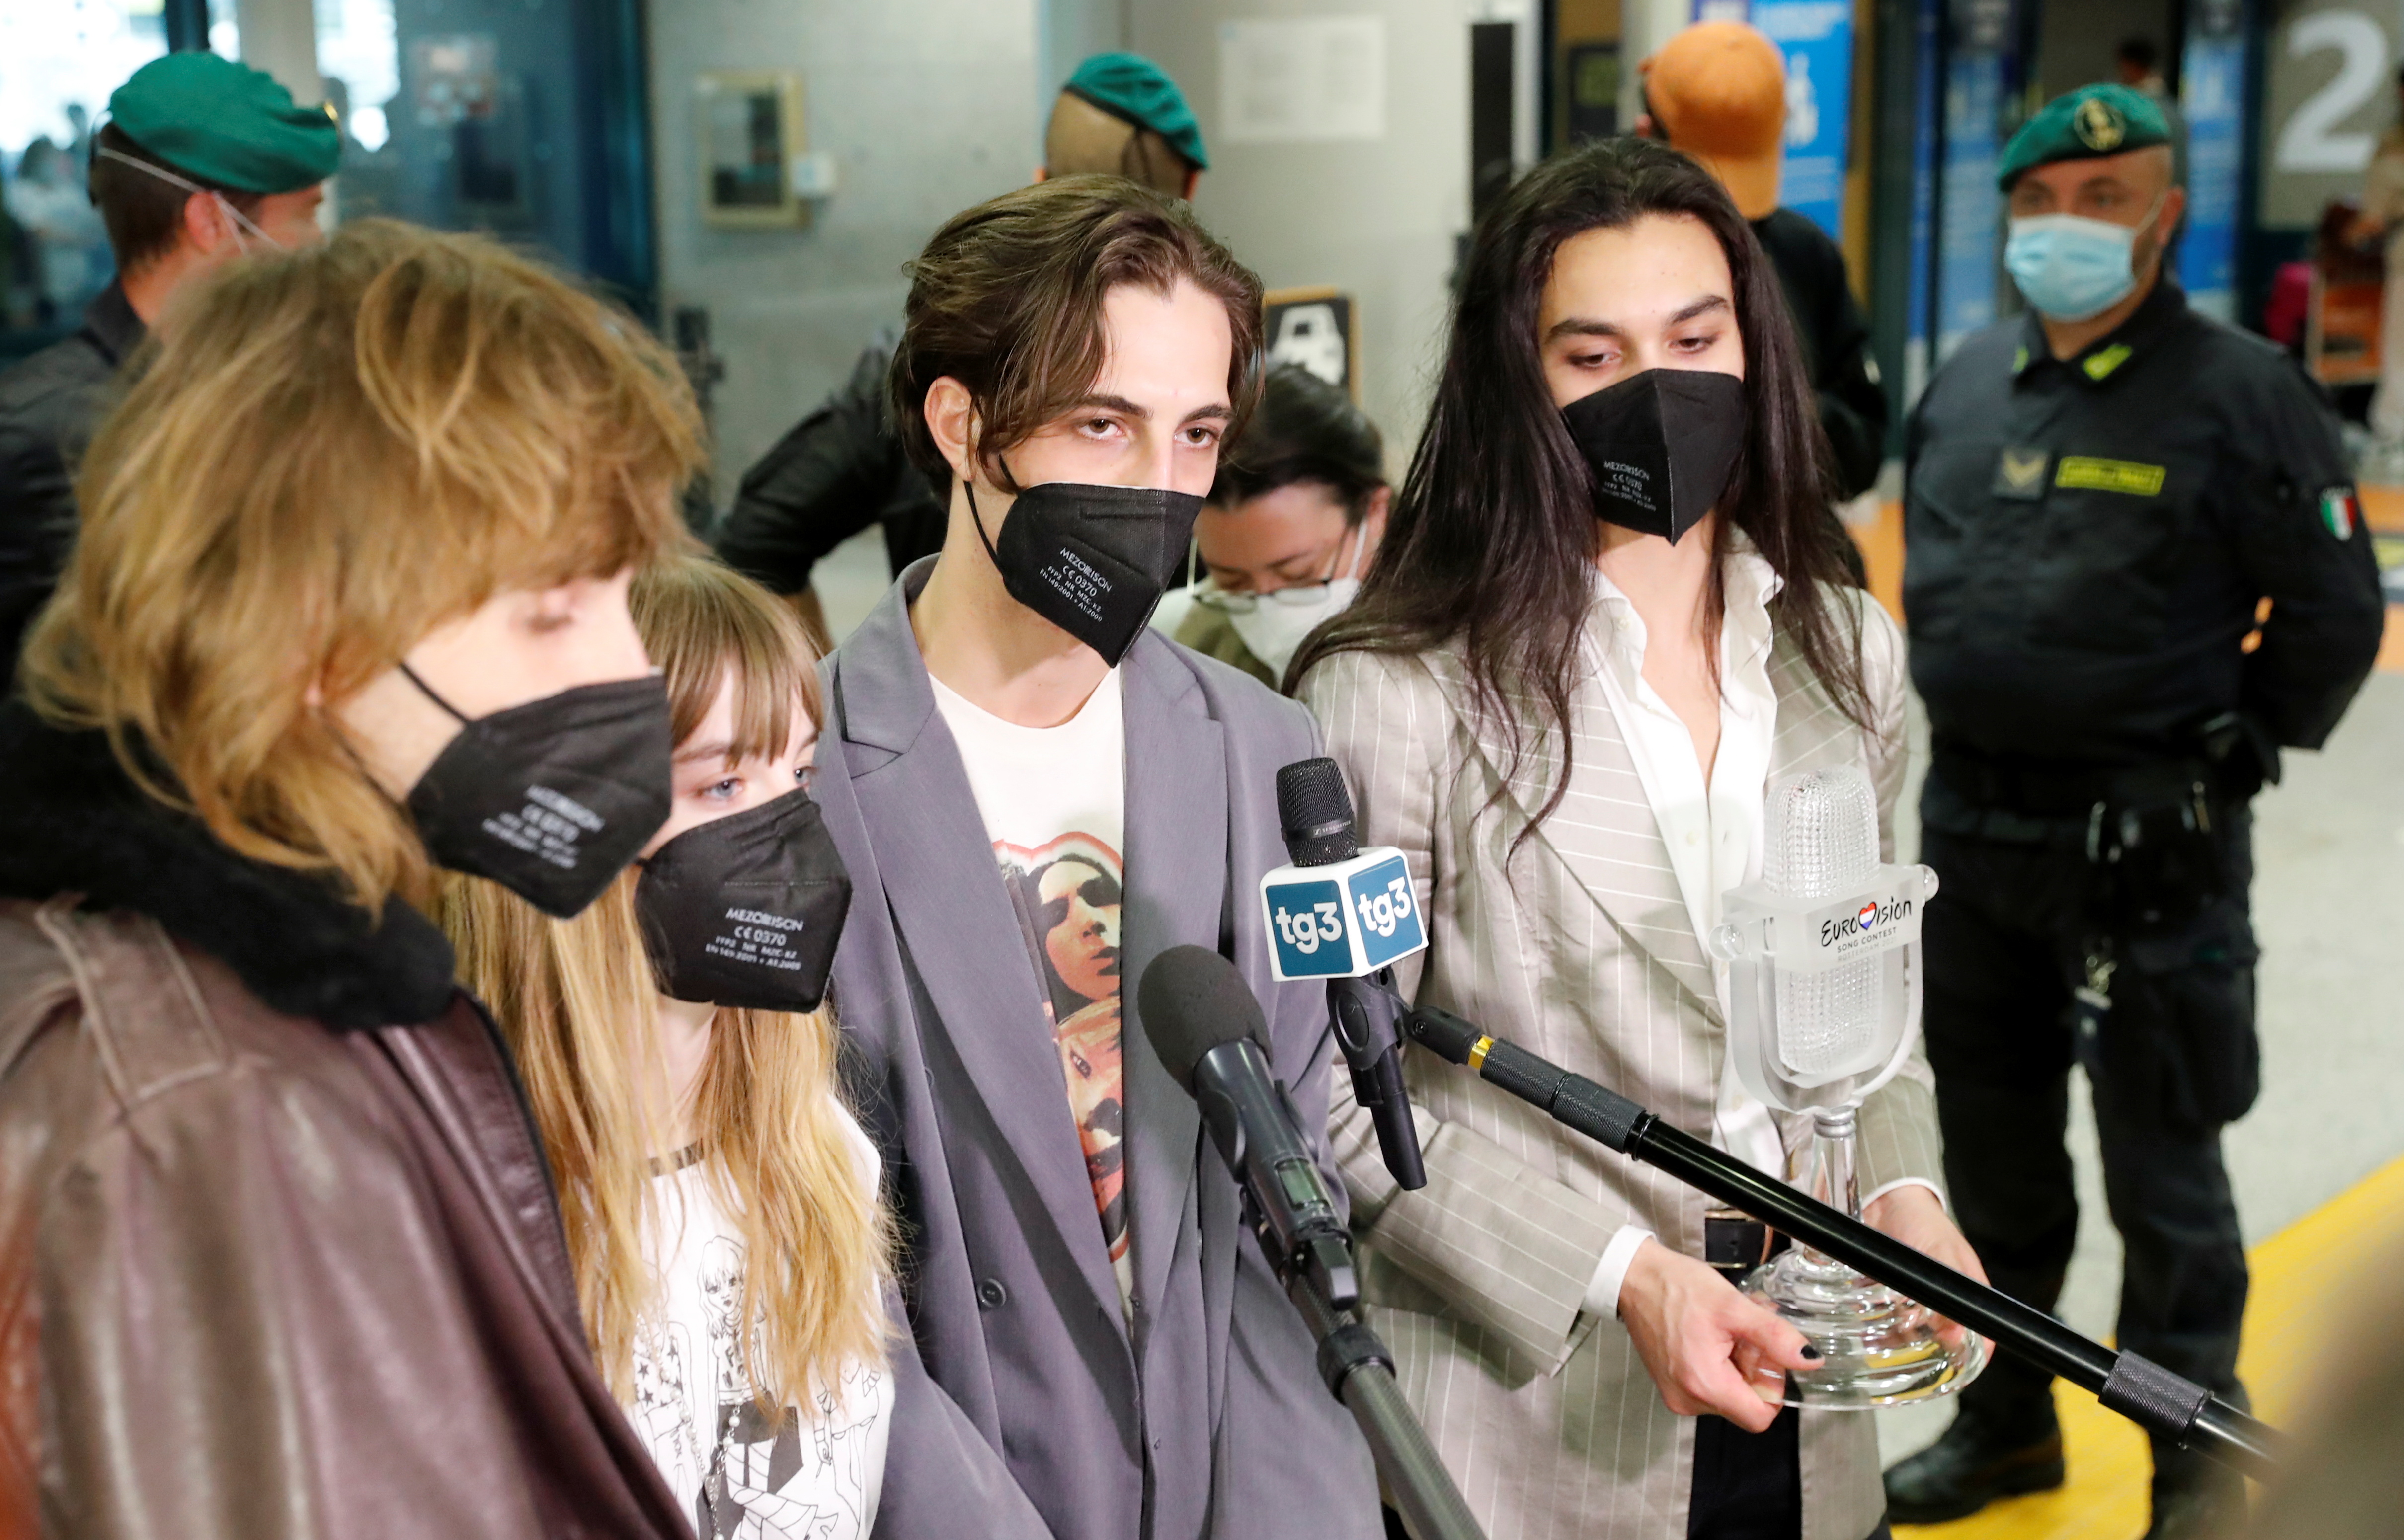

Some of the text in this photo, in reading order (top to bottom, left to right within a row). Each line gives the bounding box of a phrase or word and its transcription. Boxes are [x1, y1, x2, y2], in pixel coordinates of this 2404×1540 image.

[2276, 9, 2384, 171] 2
[1075, 575, 1097, 596] 0370
[1358, 876, 1411, 937] tg3
[753, 928, 787, 946] 0370
[1275, 902, 1343, 954] tg3
[1837, 927, 1897, 953] SONG CONTEST
